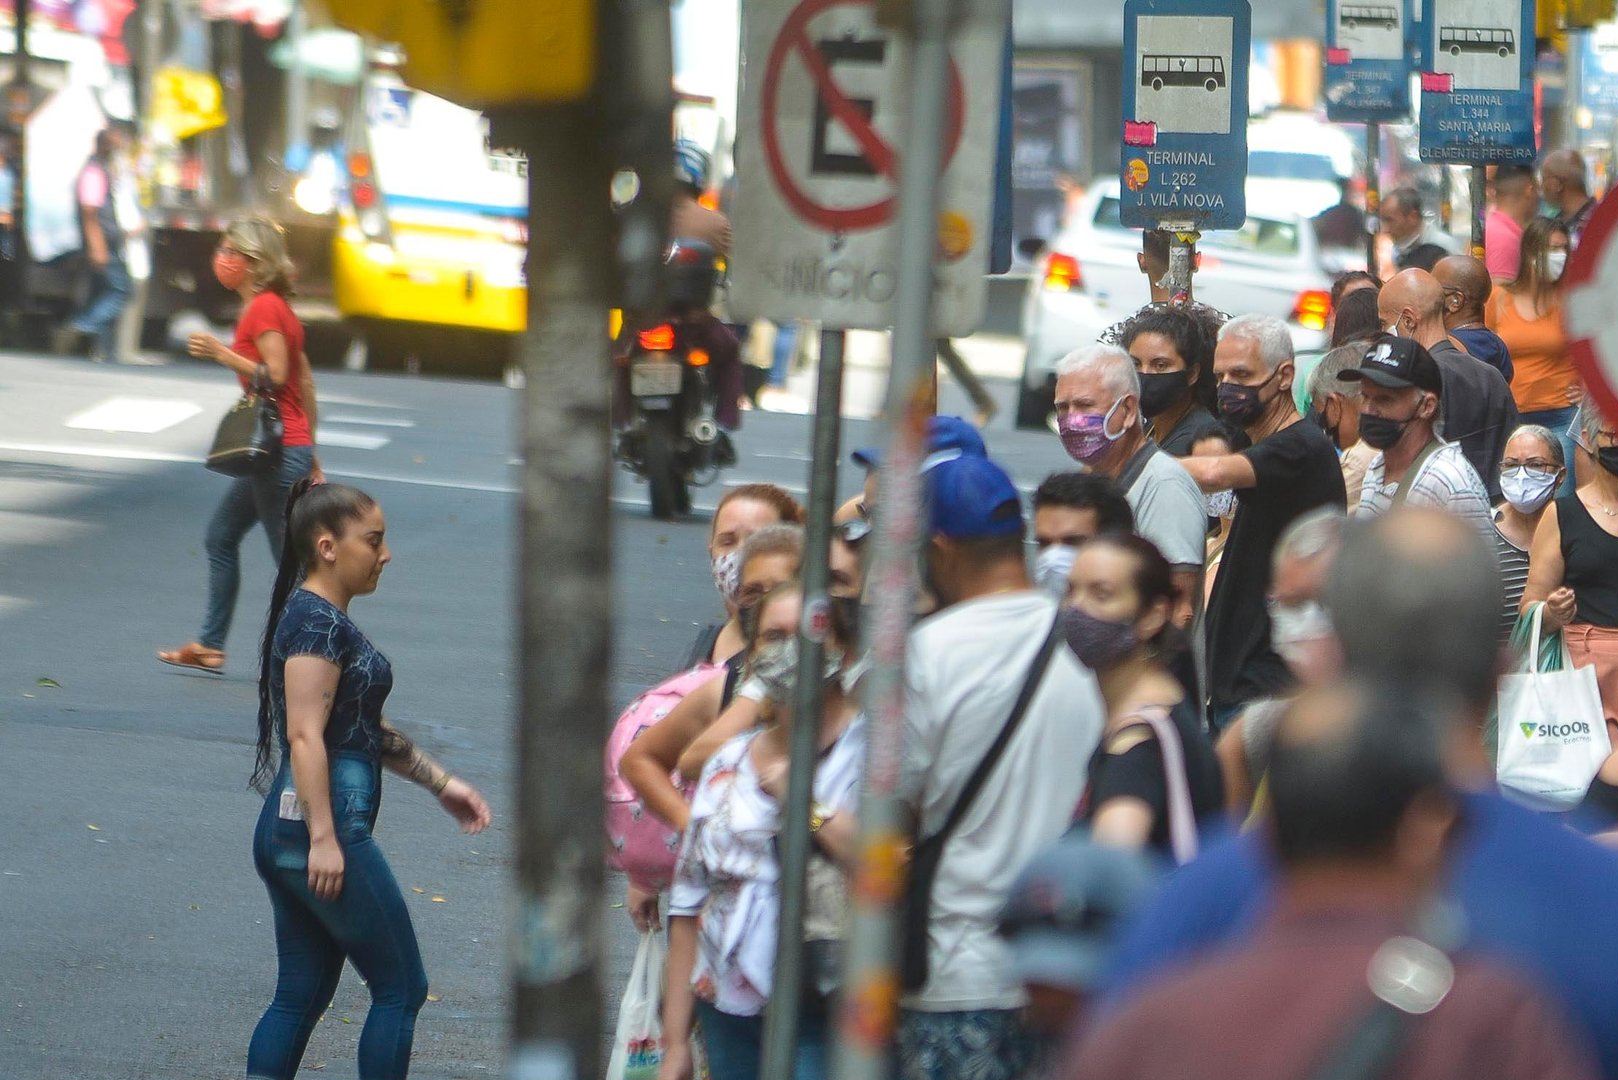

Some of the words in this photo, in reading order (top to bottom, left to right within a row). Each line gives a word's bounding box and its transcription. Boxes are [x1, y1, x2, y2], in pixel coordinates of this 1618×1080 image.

[1449, 94, 1503, 106] TERMINAL
[1462, 108, 1489, 119] L.344
[1440, 120, 1474, 132] SANTA
[1477, 122, 1512, 133] MARIA
[1147, 151, 1216, 166] TERMINAL
[1421, 147, 1480, 159] CLEMENTE
[1482, 148, 1533, 159] PEREIRA
[1161, 173, 1197, 186] L.262
[1137, 194, 1147, 206] J.
[1151, 194, 1178, 206] VILA
[1183, 194, 1225, 208] NOVA
[1538, 721, 1590, 737] SICOOB
